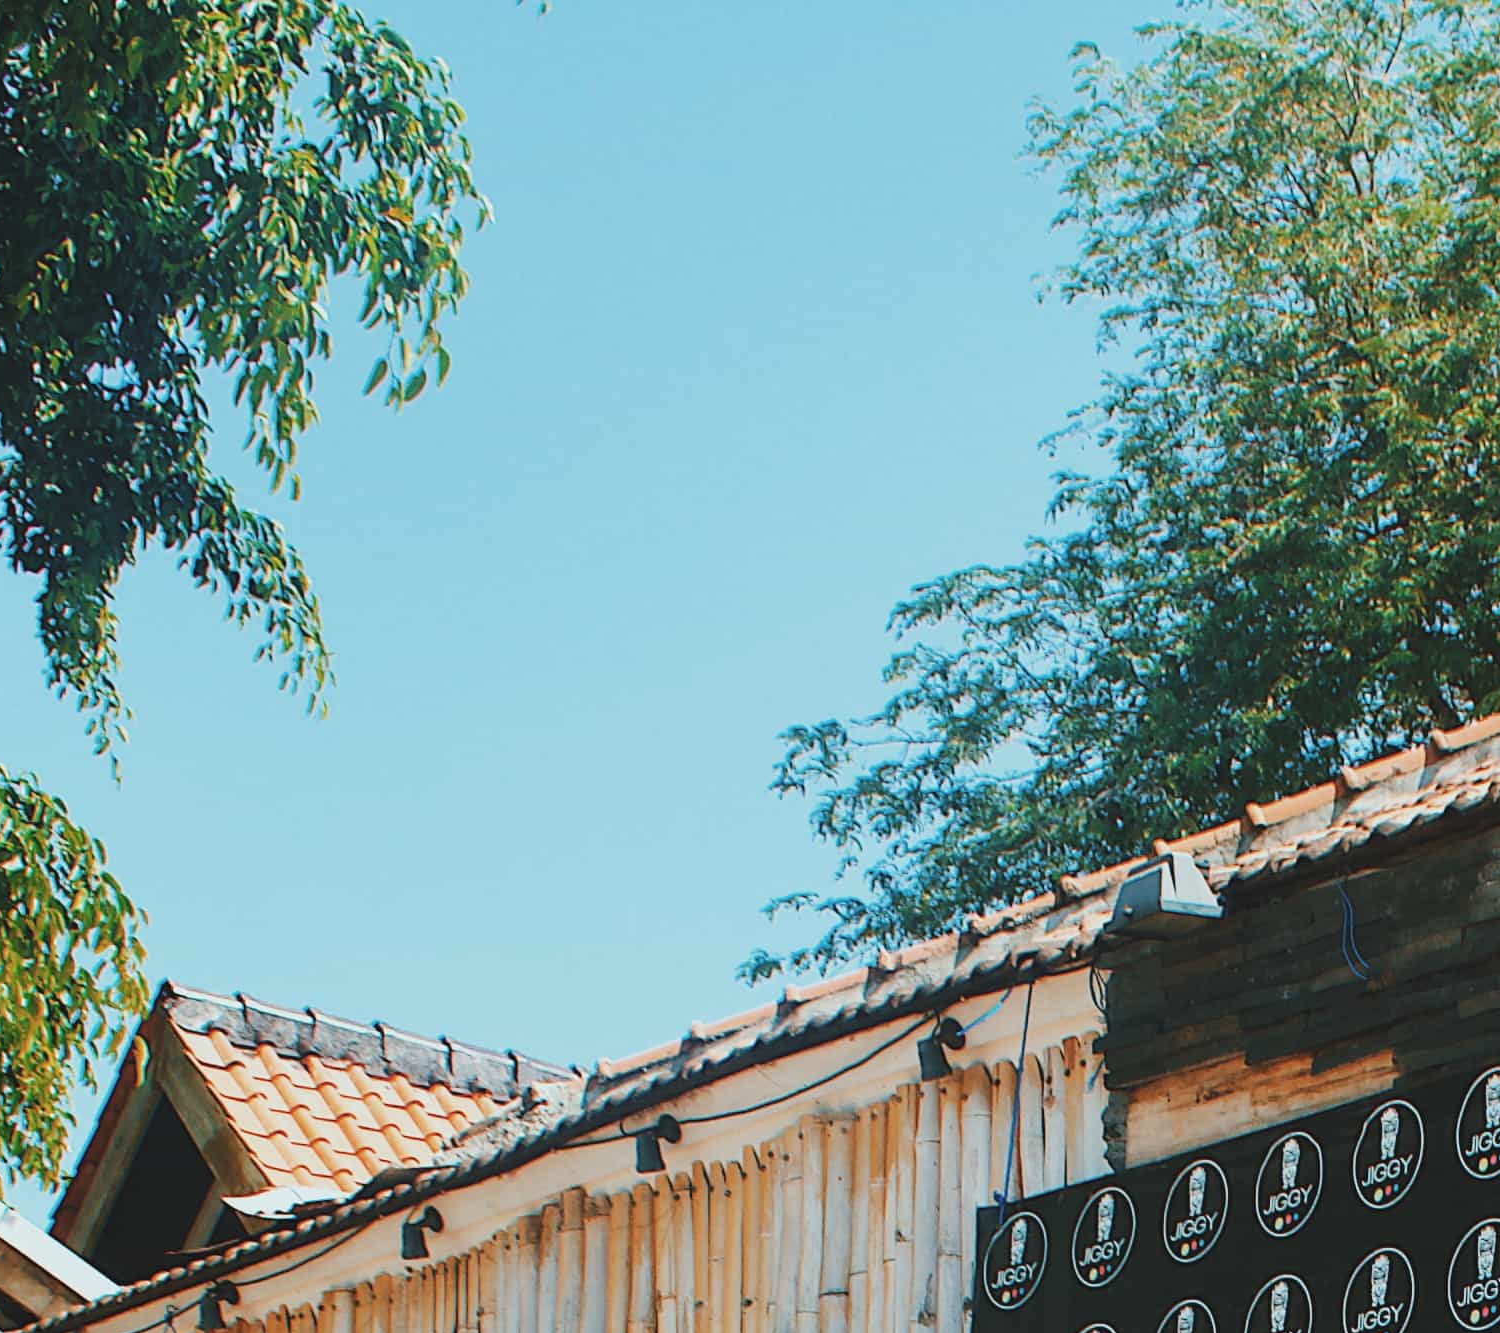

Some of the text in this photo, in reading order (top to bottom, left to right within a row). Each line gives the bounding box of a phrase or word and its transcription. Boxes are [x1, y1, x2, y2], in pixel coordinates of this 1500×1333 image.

[1362, 1154, 1413, 1187] JIGGY
[1264, 1184, 1312, 1215] JIGGY
[1172, 1212, 1218, 1241] JIGGY
[1080, 1239, 1124, 1266] JIGGY
[991, 1262, 1037, 1288] JIGGY
[1351, 1303, 1403, 1333] JIGGY
